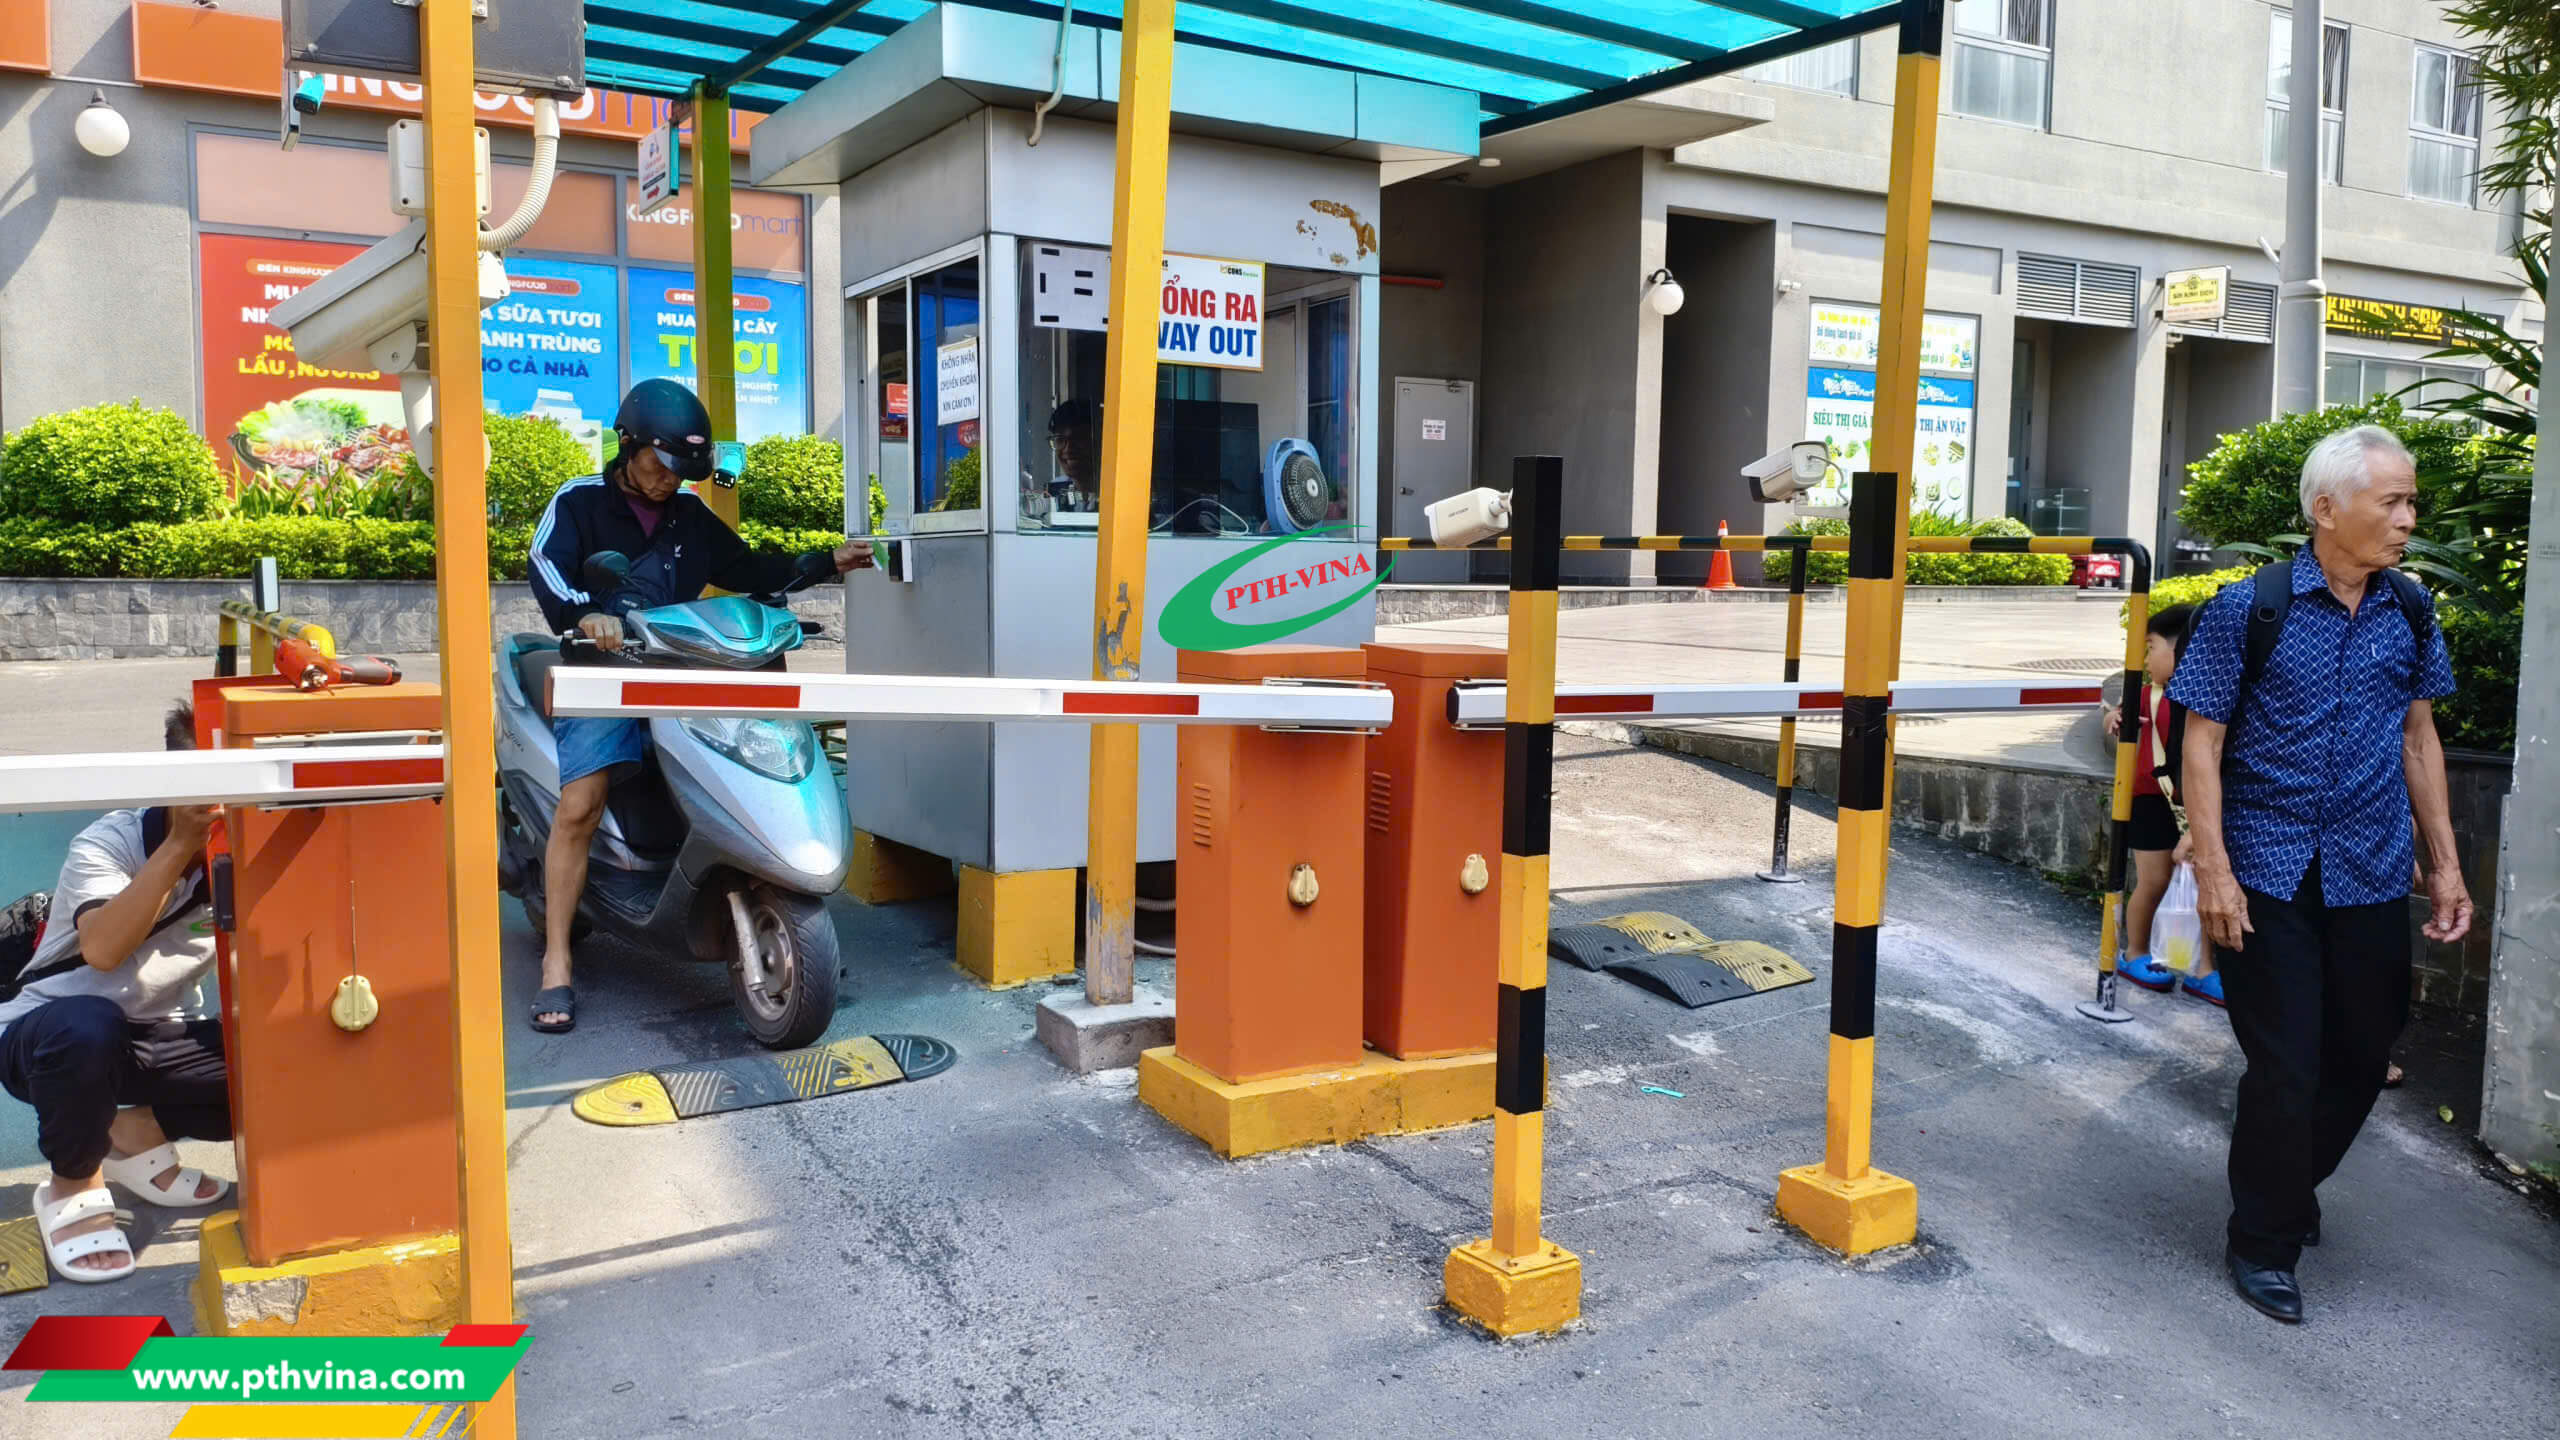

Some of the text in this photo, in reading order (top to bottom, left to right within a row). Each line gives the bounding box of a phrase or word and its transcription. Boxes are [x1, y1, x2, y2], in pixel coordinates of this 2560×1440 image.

[1162, 274, 1258, 323] ỔNG RA
[497, 303, 544, 325] SỮA
[547, 309, 602, 329] TƯƠI
[743, 317, 778, 335] CÂY
[1209, 326, 1257, 357] OUT
[544, 360, 590, 379] NHÀ
